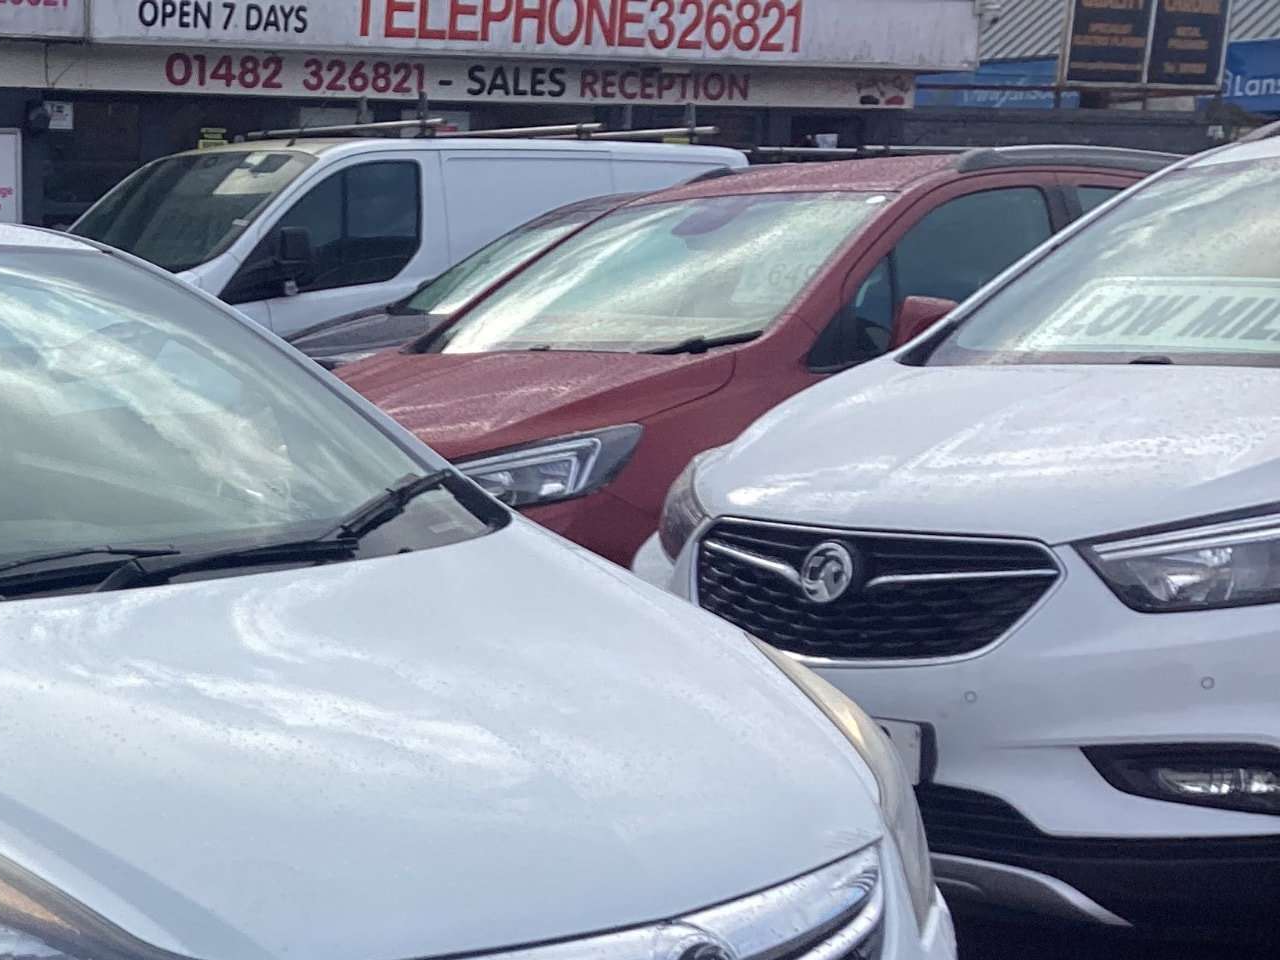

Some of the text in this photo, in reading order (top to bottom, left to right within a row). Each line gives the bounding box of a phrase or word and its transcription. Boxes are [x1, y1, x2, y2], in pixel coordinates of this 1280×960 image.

[138, 0, 308, 33] OPEN 7 DAYS
[165, 52, 283, 88] 01482
[302, 57, 425, 93] 326821
[466, 65, 566, 97] SALES
[580, 69, 750, 100] RECEPTION
[1177, 296, 1280, 343] MIL
